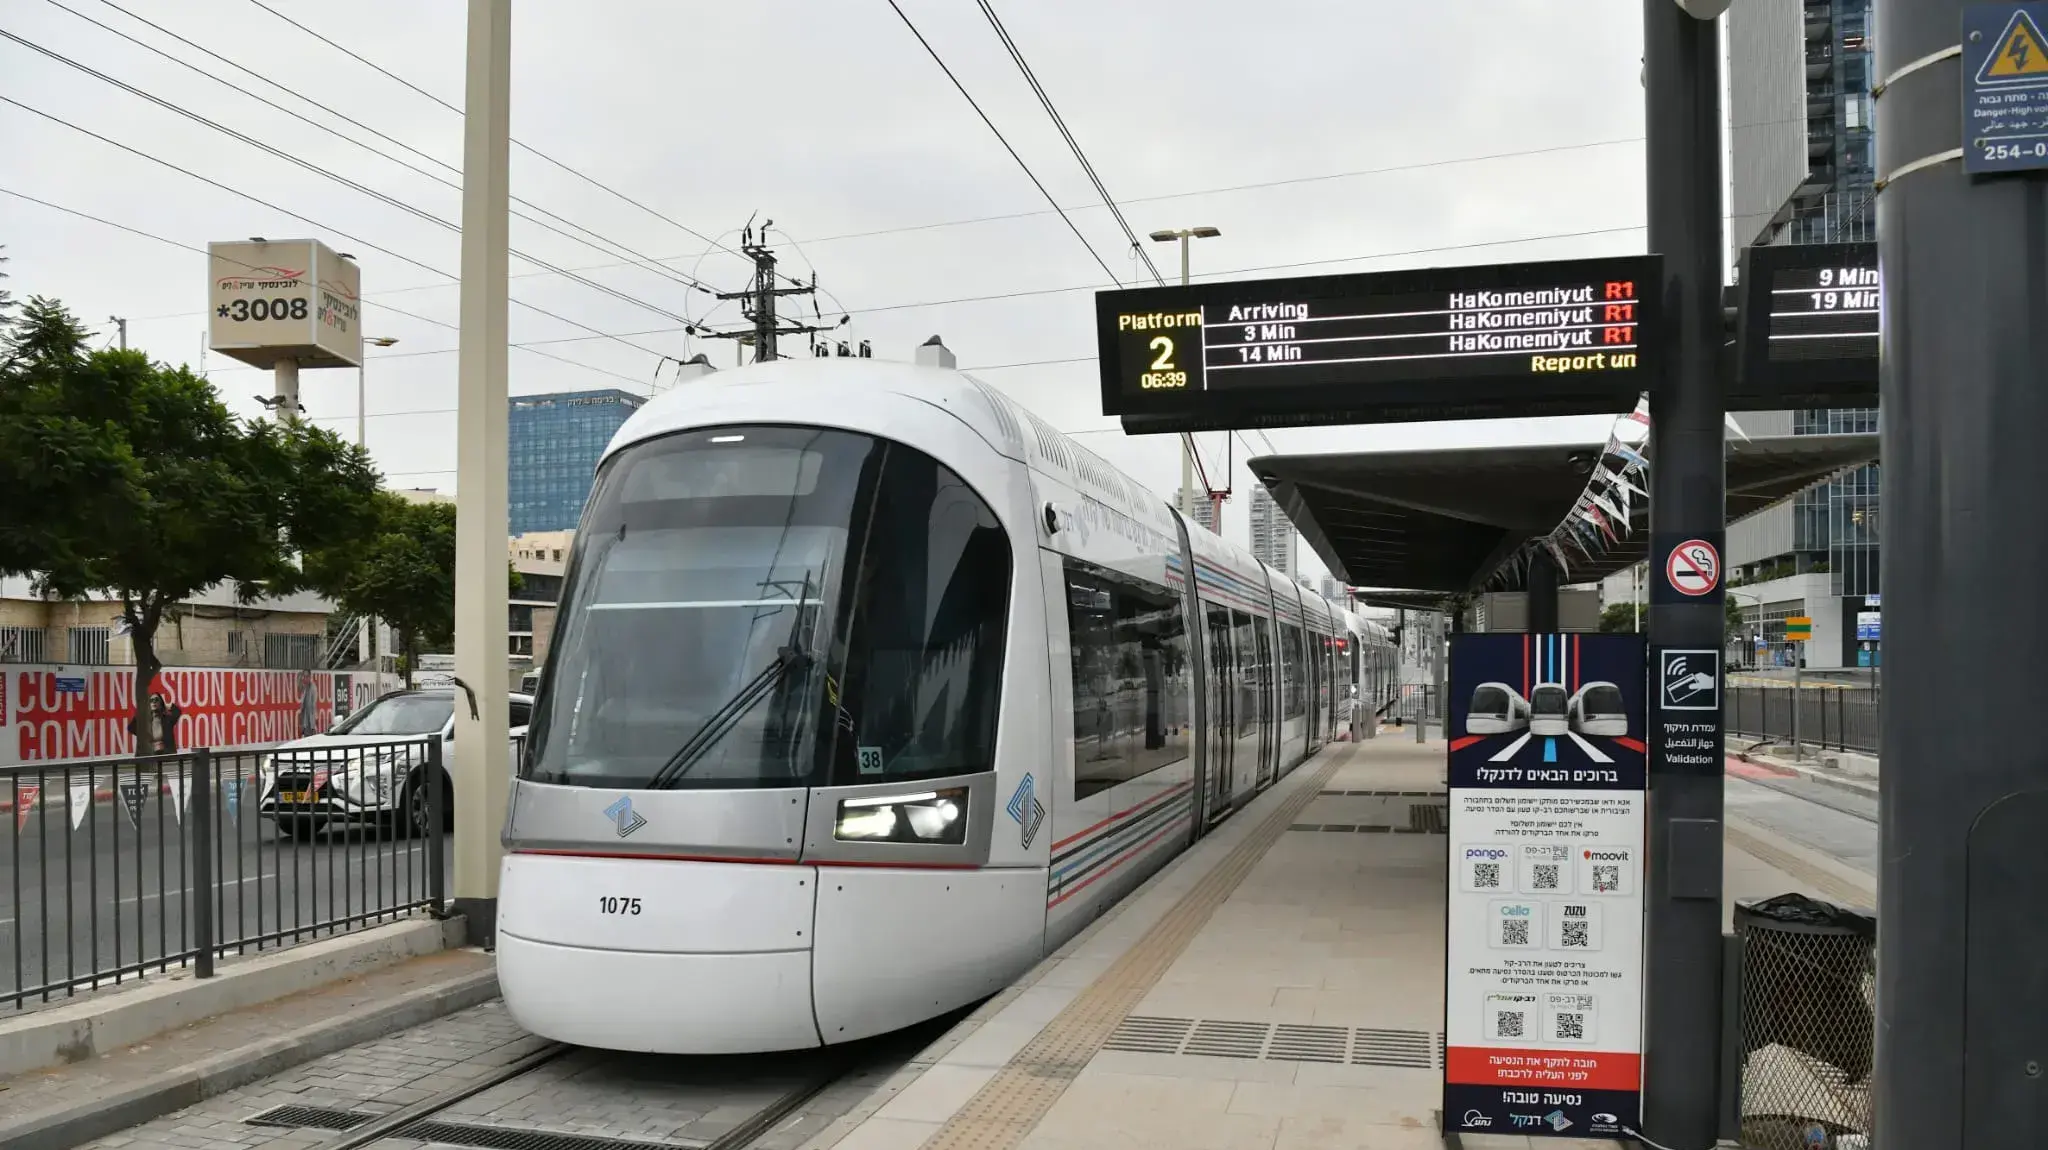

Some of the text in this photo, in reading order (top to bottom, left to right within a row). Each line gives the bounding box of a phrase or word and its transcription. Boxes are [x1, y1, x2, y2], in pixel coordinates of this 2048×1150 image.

[1984, 143, 2048, 160] 254-0
[1819, 268, 1878, 286] 9 Min
[1450, 281, 1633, 309] HaKomemiyut R1
[1810, 291, 1880, 310] 19 Min
[1229, 303, 1309, 321] Arriving
[1450, 304, 1632, 330] HaKomemiyut R1
[1119, 313, 1201, 331] Platform
[1244, 324, 1296, 341] 3 Min
[1450, 326, 1632, 351] HaKomemiyut R1
[1150, 336, 1175, 370] 2
[1239, 345, 1302, 362] 14 Min
[1531, 353, 1637, 373] Report un
[1141, 372, 1187, 389] 06:39
[161, 671, 225, 708] SOON
[17, 719, 137, 760] COMIN
[177, 713, 225, 750] OON
[1664, 723, 1715, 733] עמדת תיקוף
[1665, 738, 1714, 749] جهاز التفعيل
[862, 752, 880, 768] 38
[1666, 754, 1713, 764] Validation
[1476, 767, 1618, 783] ברוכים הבאים לדנקל!
[1526, 846, 1550, 854] רב-פס
[1592, 851, 1629, 861] moovit
[600, 897, 641, 915] 1075
[1564, 905, 1586, 916] ZUZU
[1550, 995, 1575, 1003] רב-פס
[1489, 1056, 1596, 1068] חובה לתקף את הנסיעה
[1498, 1068, 1588, 1080] לפני העליה לרכבת!
[1503, 1091, 1582, 1106] נסיעה טובה!
[1510, 1112, 1541, 1128] דנקל
